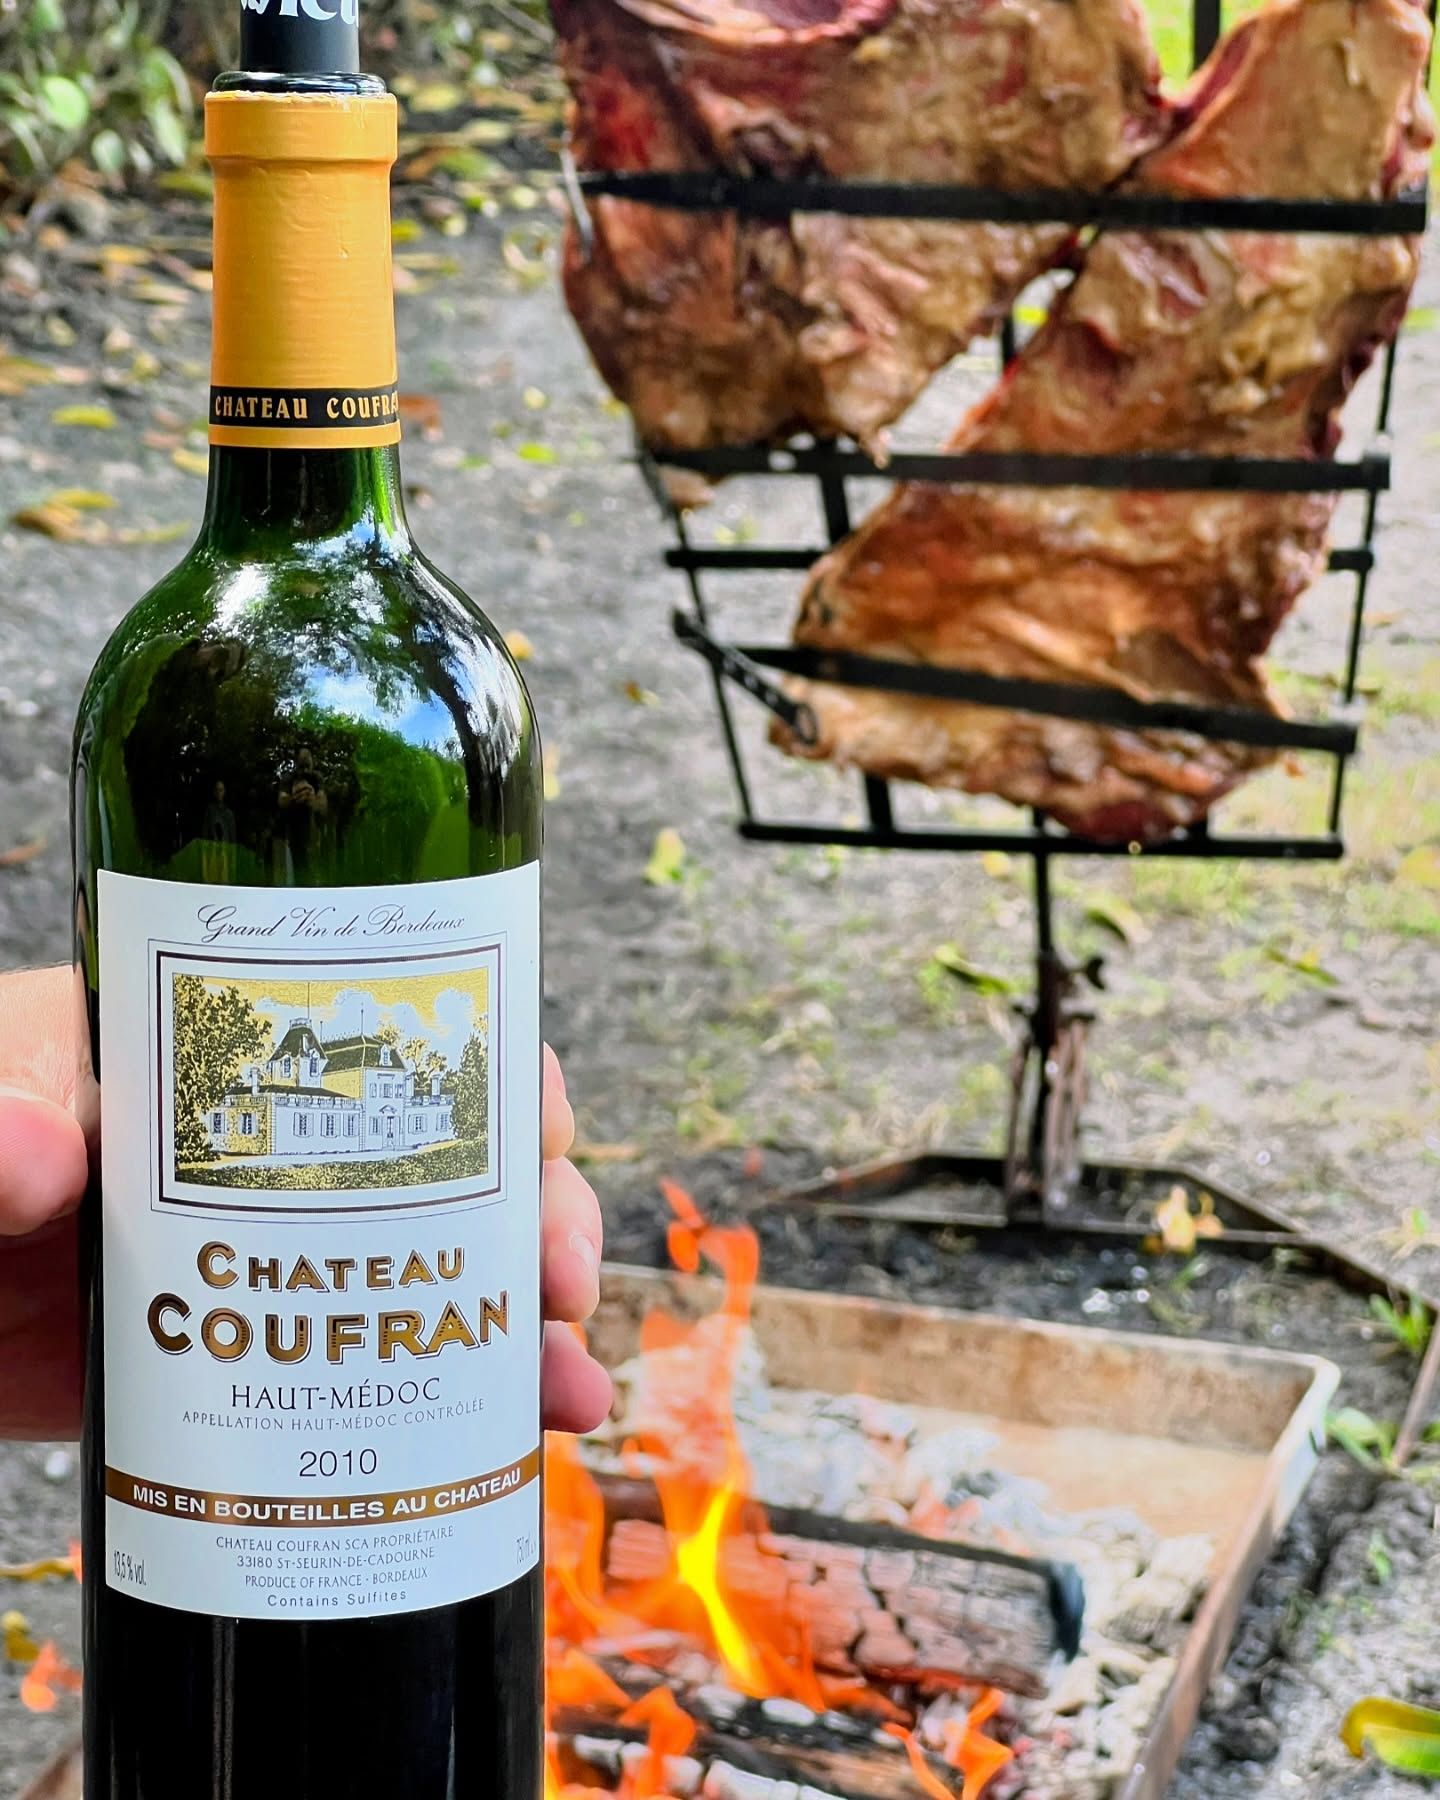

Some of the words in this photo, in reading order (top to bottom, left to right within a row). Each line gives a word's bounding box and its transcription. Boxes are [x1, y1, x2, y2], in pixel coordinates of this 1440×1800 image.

[215, 395, 308, 419] CHATEAU
[197, 904, 287, 943] Grand
[290, 907, 336, 937] Vin
[334, 914, 358, 937] de
[363, 903, 465, 936] Bordeaux
[197, 1240, 465, 1293] CHATEAU
[147, 1290, 510, 1365] COUFRAN
[231, 1377, 441, 1410] HAUT-MÉDOC
[182, 1410, 284, 1430] APPELLATION
[291, 1413, 397, 1431] HAUT-MÉDOC
[403, 1397, 485, 1425] CONTRÔLÉE
[299, 1448, 378, 1477] 2010
[133, 1484, 168, 1508] MIS
[174, 1494, 206, 1515] EN
[214, 1500, 385, 1521] BOUTEILLES
[392, 1495, 427, 1516] AU
[434, 1467, 521, 1508] CHATEAU
[216, 1536, 272, 1551] CHATEAU
[277, 1540, 340, 1552] COUFRAN
[344, 1538, 369, 1551] SCA
[373, 1526, 454, 1549] PROPRIÉTAIRE
[236, 1555, 273, 1569] 33180
[245, 1575, 296, 1588] PRODUCE
[299, 1576, 315, 1588] OF
[318, 1574, 362, 1588] FRANCE
[372, 1567, 428, 1585] BORDEAUX
[267, 1594, 338, 1607] Contains
[347, 1590, 407, 1606] Sulfites
